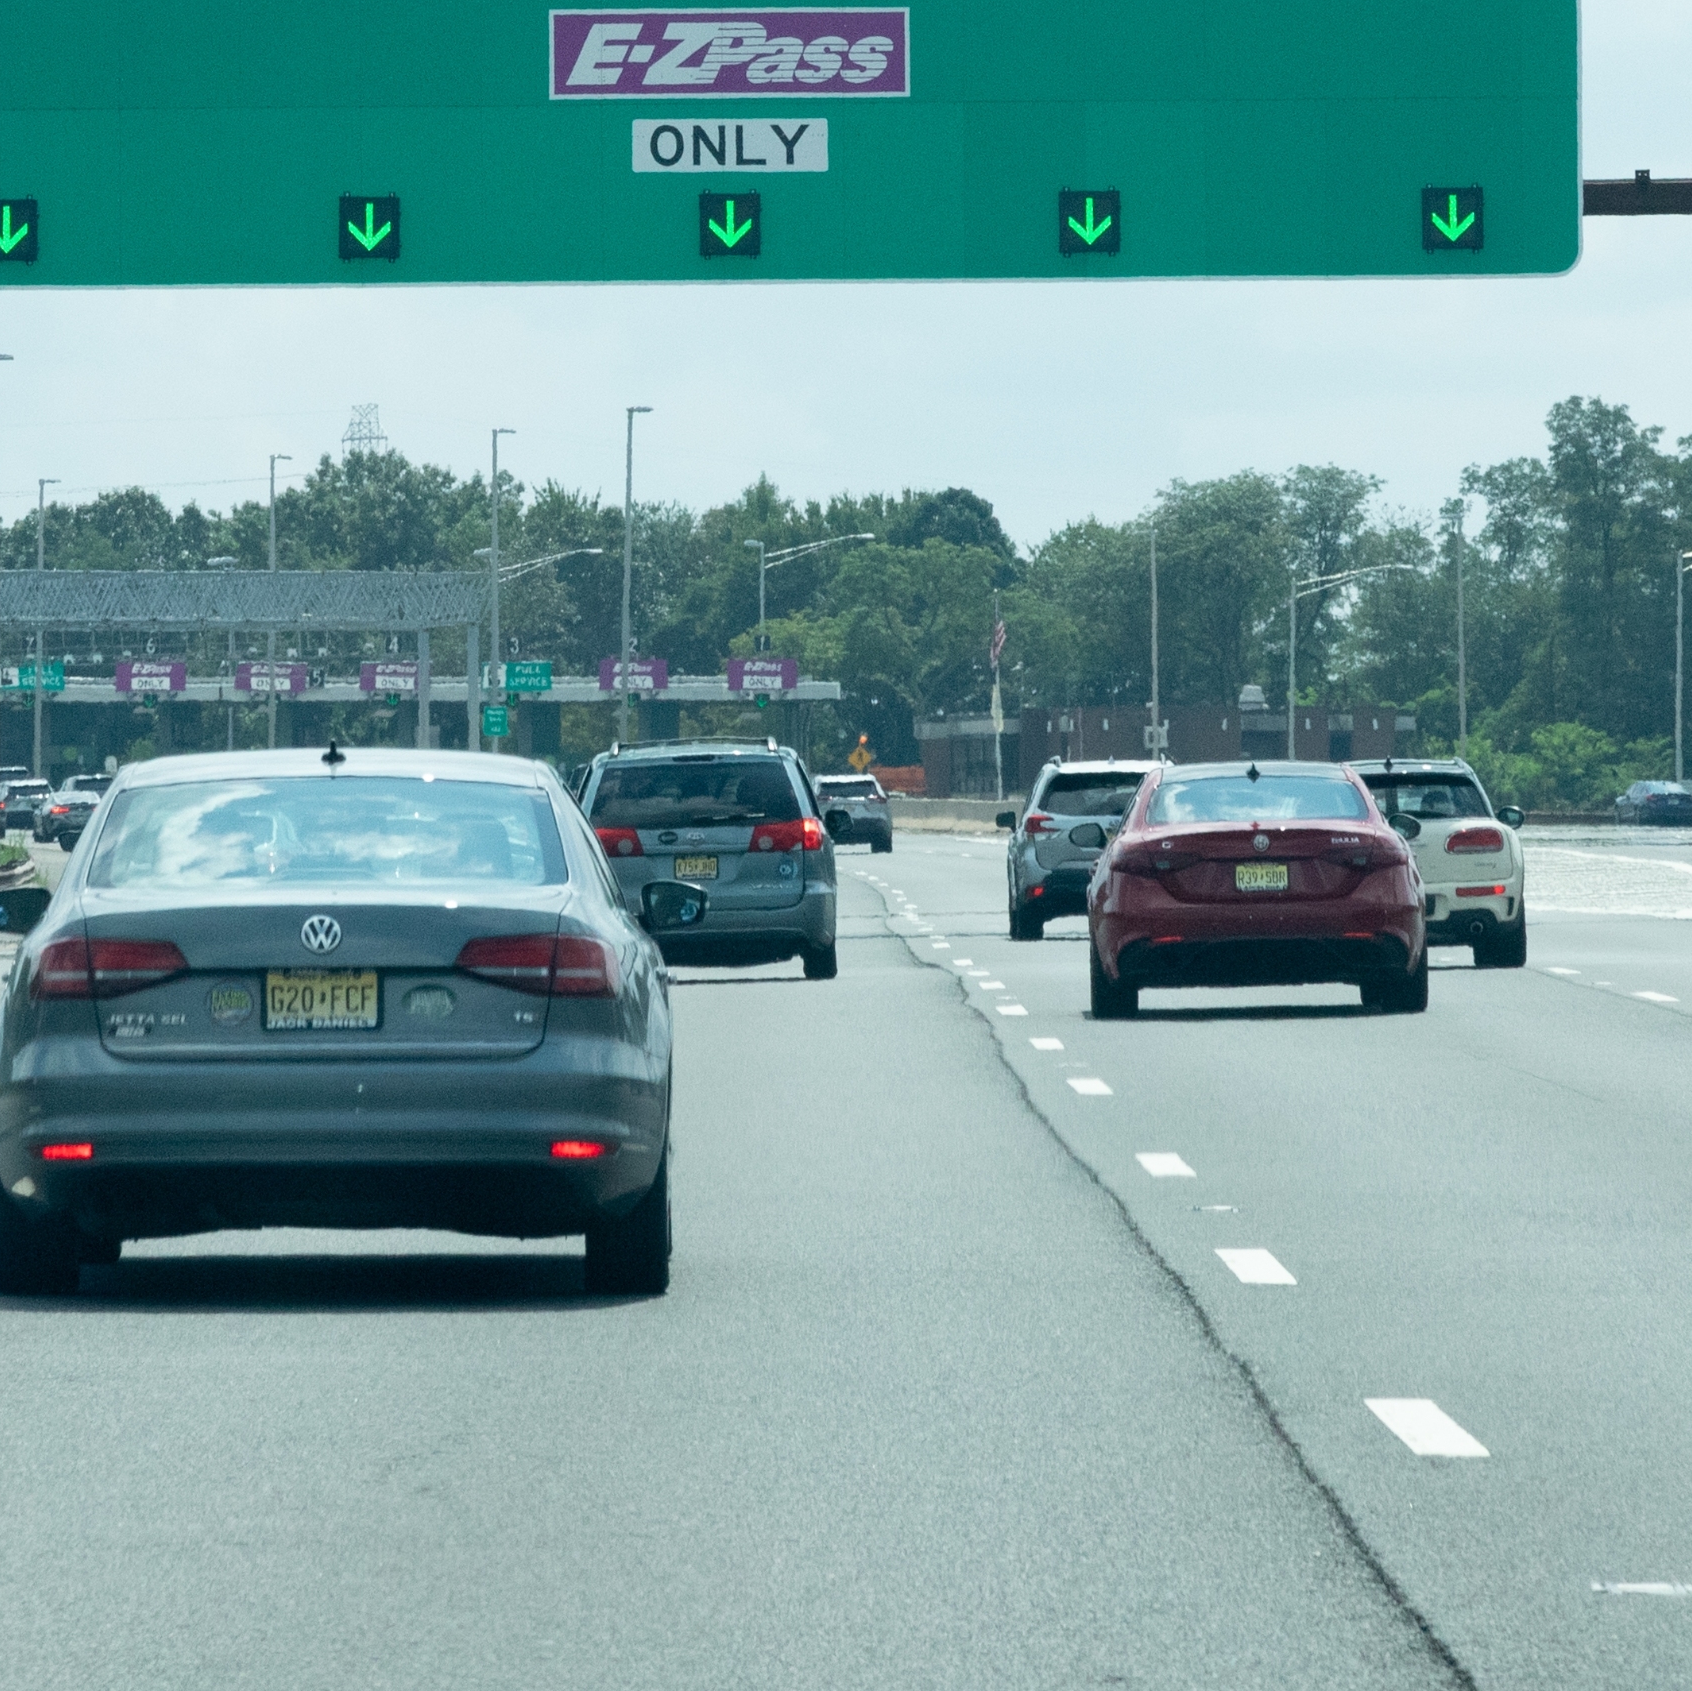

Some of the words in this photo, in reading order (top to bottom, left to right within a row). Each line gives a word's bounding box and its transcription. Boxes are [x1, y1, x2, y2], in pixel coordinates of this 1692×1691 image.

[565, 21, 895, 86] E-ZPass
[649, 124, 810, 168] ONLY
[146, 637, 156, 654] 6
[510, 637, 519, 654] 3
[256, 679, 285, 688] ONY
[749, 677, 777, 687] ONLY
